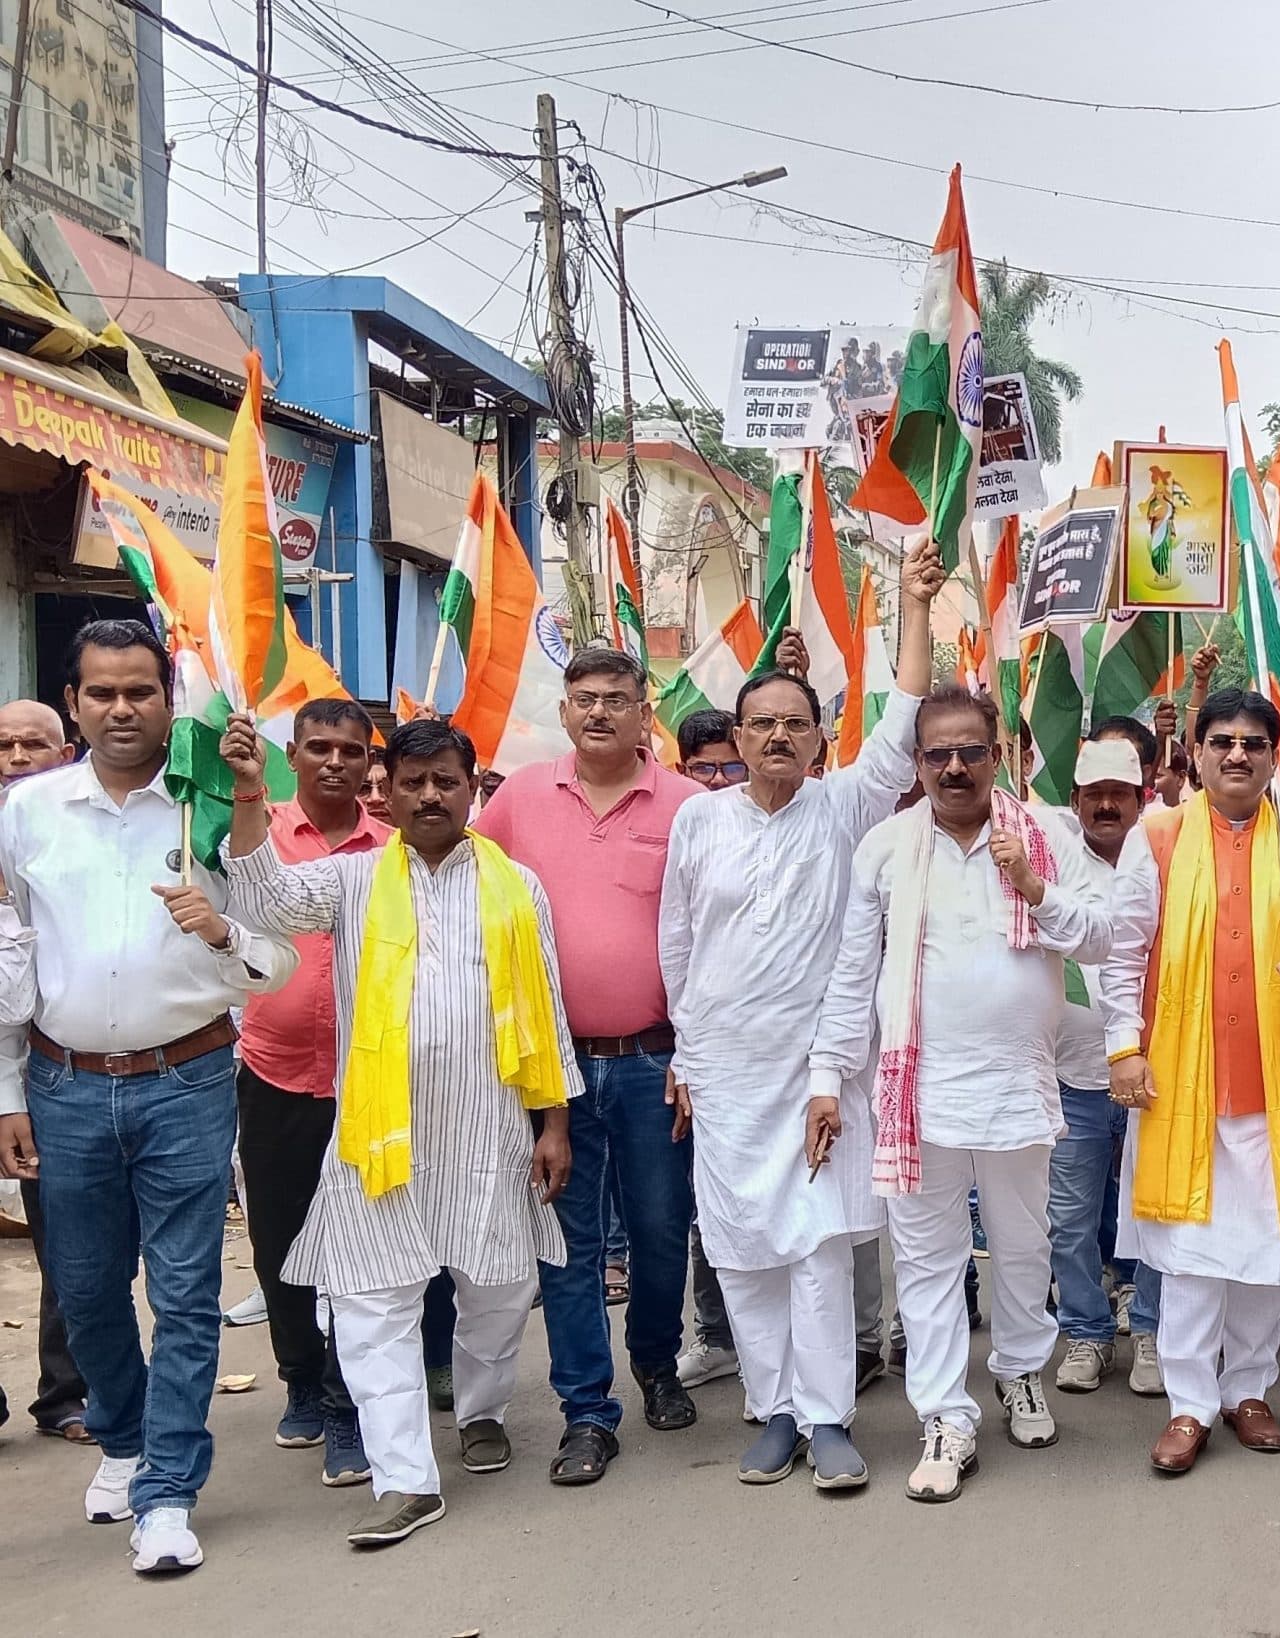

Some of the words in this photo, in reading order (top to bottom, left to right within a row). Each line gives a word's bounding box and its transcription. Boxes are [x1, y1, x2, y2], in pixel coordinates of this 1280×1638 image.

[763, 342, 811, 358] OPERATION
[746, 398, 775, 418] सेना
[777, 402, 794, 418] का
[13, 389, 108, 455] Deepak
[746, 423, 768, 439] एक
[266, 453, 308, 504] TURE
[994, 470, 1017, 486] देखा,
[1000, 488, 1019, 504] देखा
[175, 502, 210, 533] interio
